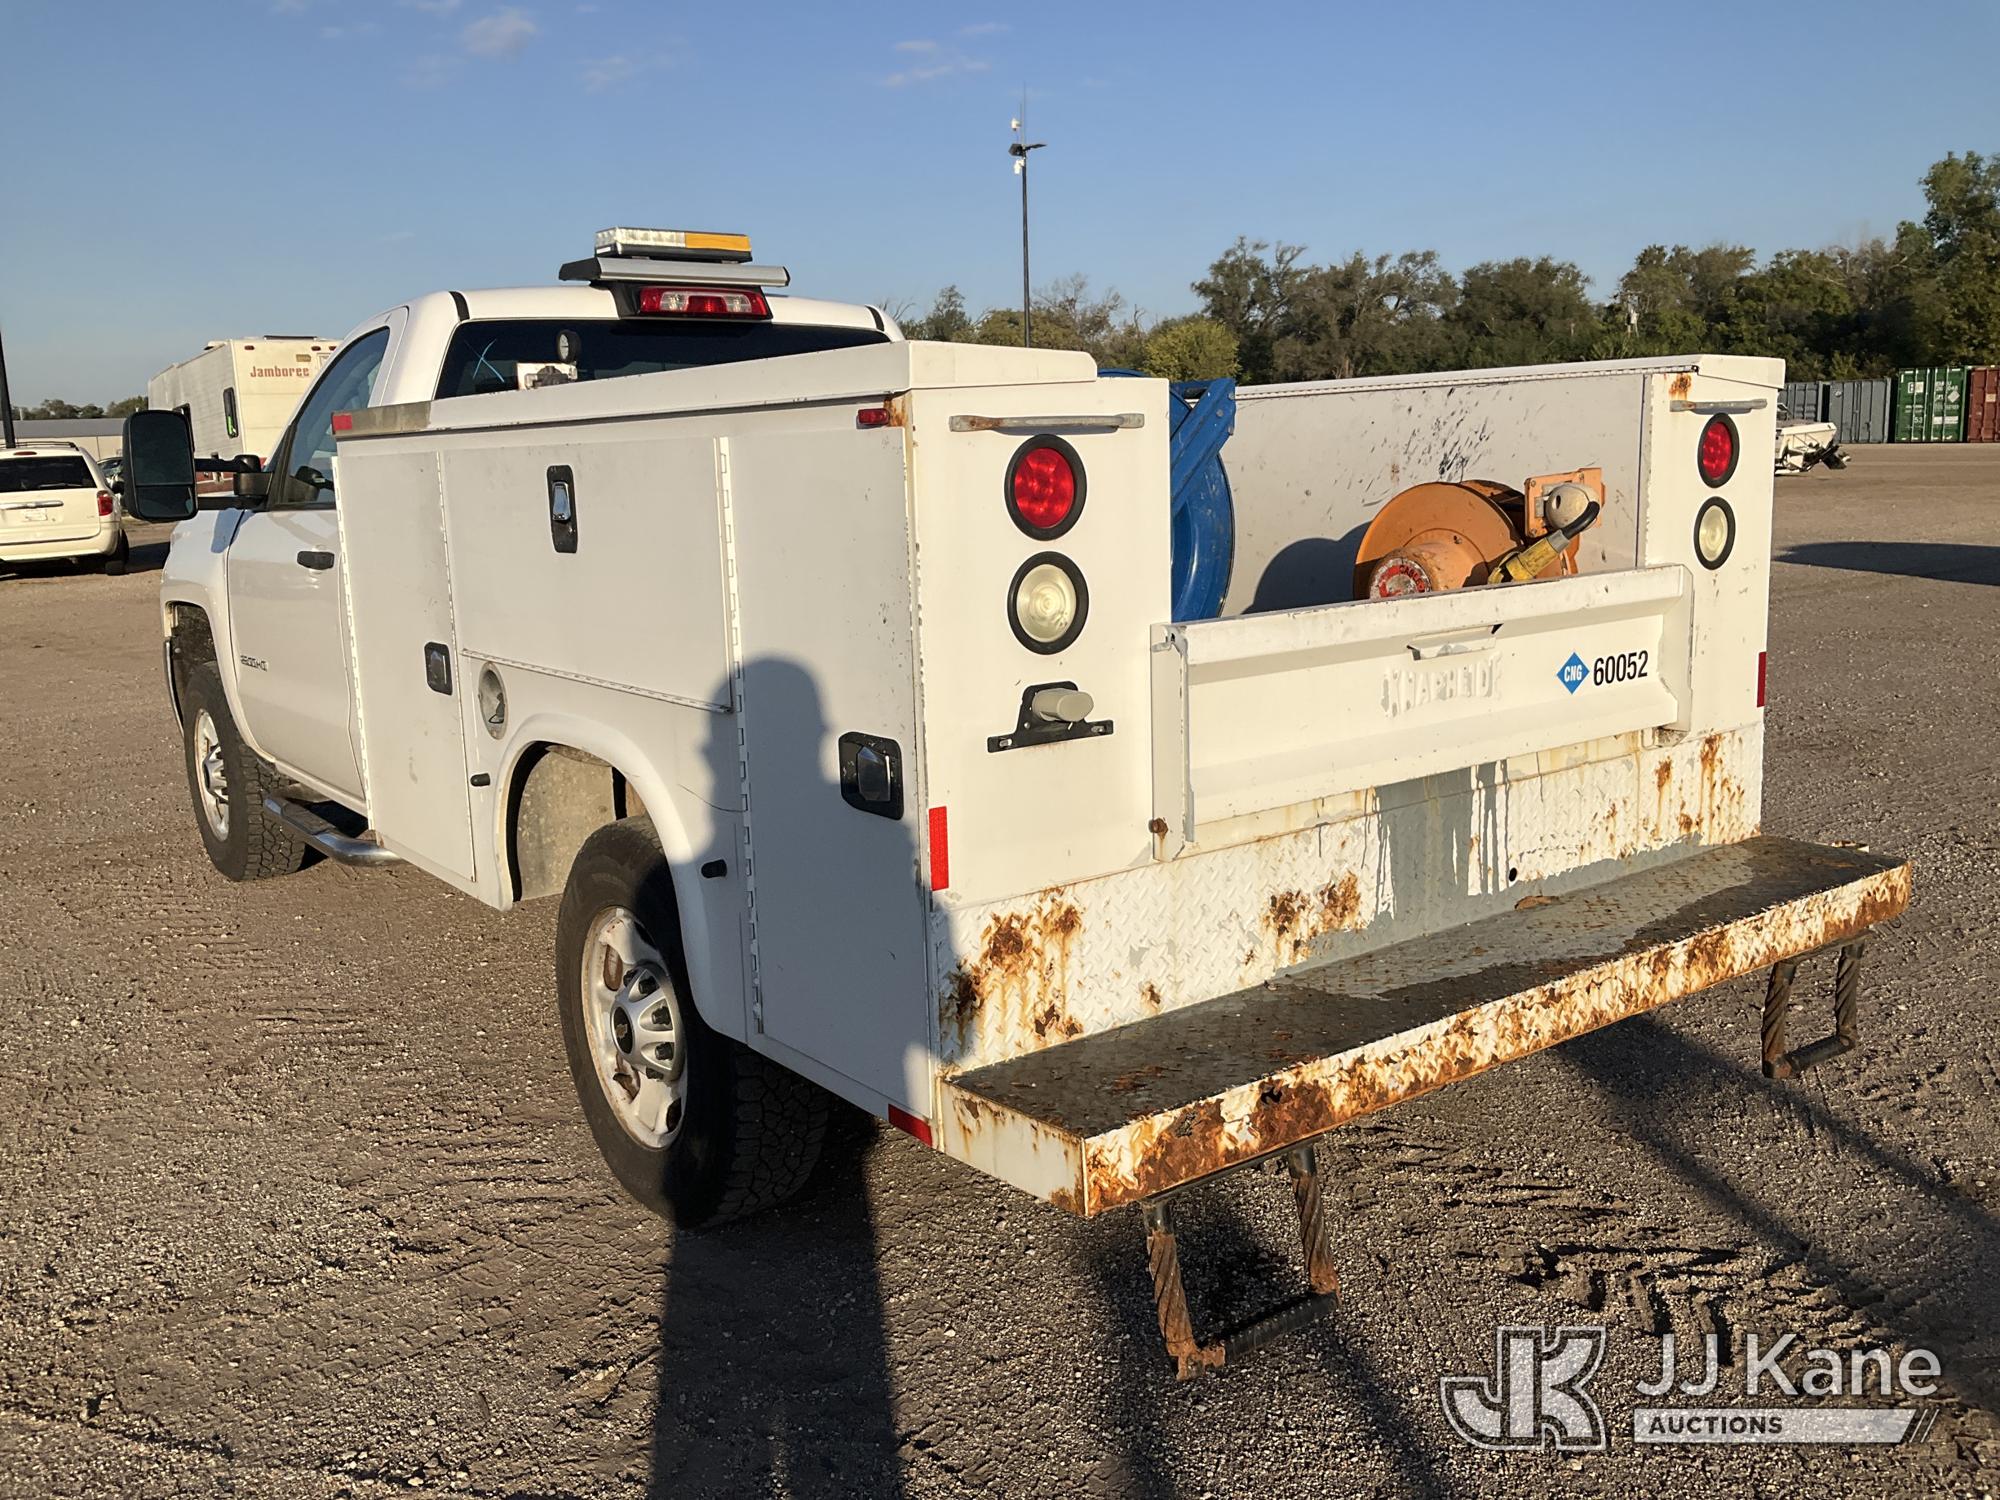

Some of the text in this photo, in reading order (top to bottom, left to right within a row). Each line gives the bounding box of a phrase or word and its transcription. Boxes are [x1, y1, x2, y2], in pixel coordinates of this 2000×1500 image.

[250, 366, 310, 378] Jamboree
[1563, 650, 1649, 687] CNG 60052
